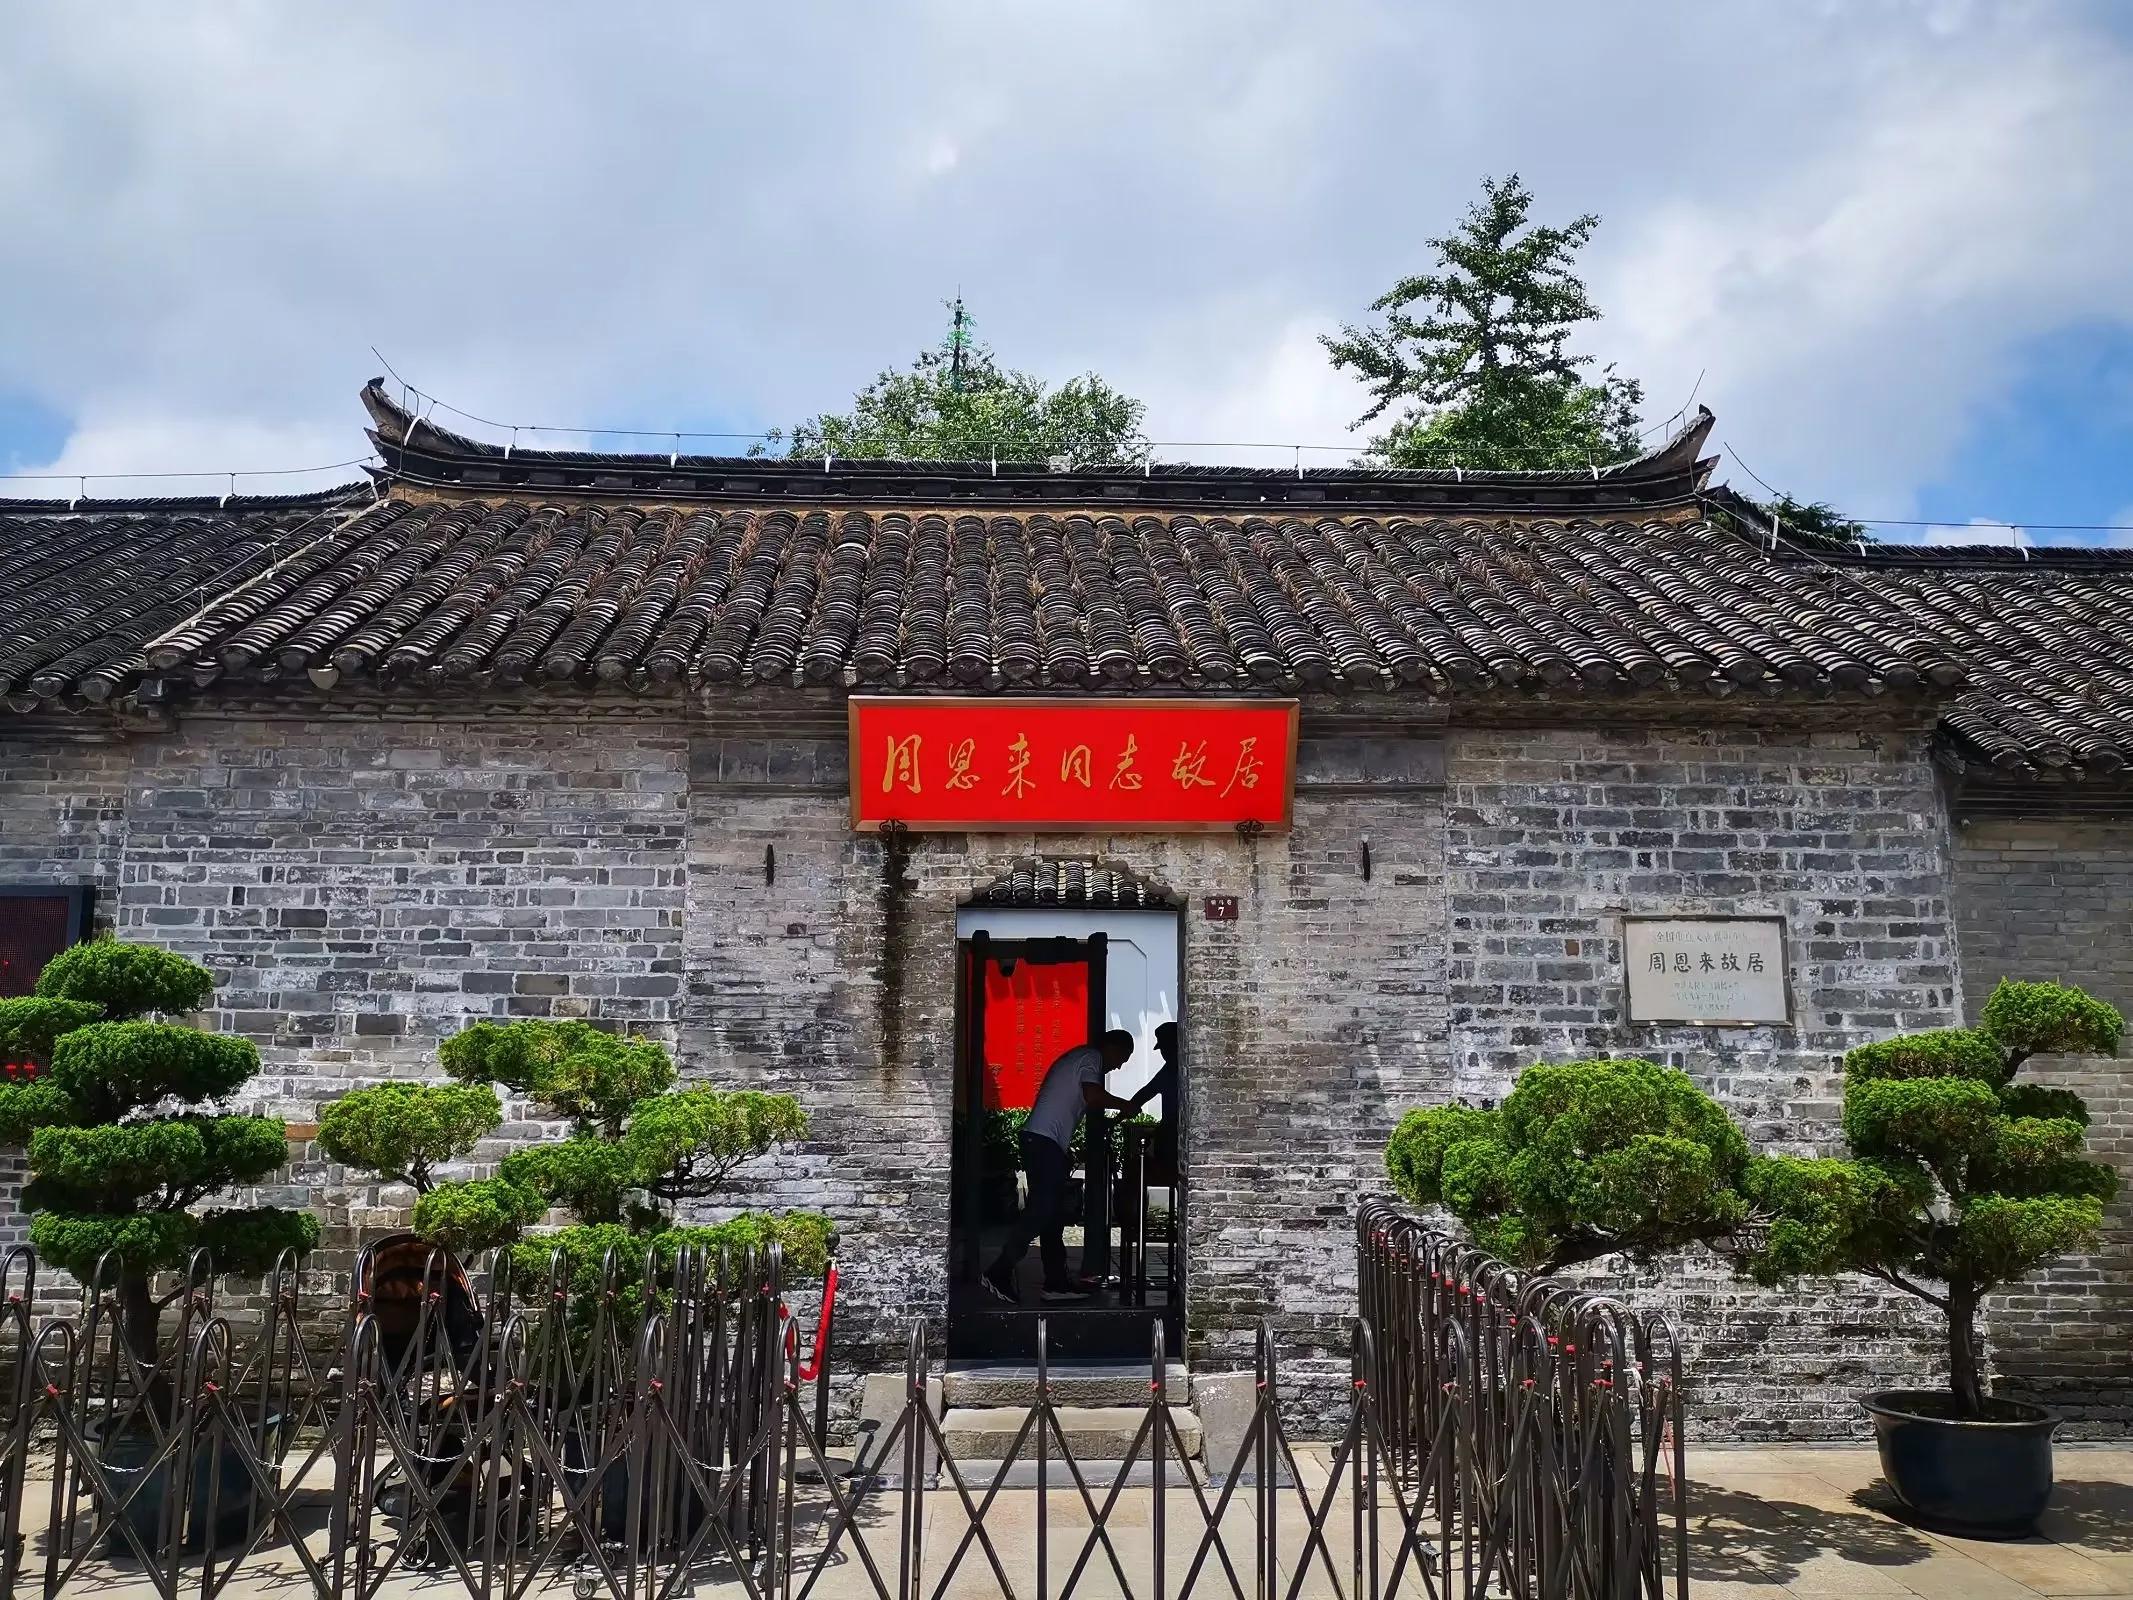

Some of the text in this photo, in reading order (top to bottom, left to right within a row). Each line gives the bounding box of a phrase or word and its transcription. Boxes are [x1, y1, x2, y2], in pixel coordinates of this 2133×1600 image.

[882, 732, 1264, 798] 周恩来同志故居
[1217, 906, 1225, 917] 7
[1648, 952, 1764, 974] 周恩来故居
